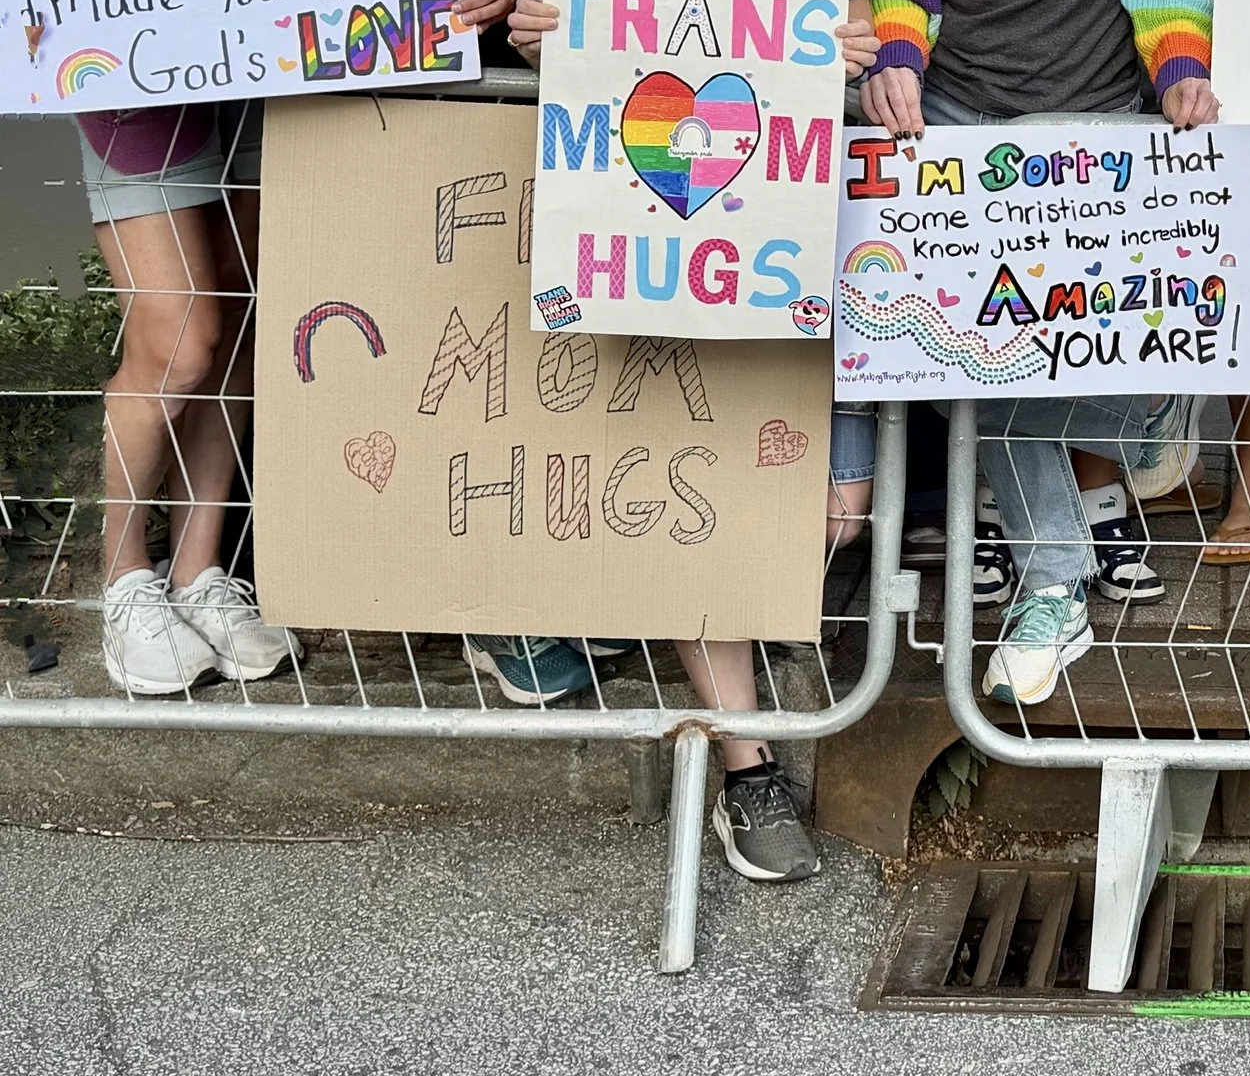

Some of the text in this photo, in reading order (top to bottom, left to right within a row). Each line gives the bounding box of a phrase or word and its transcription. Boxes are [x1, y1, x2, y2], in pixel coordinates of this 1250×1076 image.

[129, 28, 267, 94] God's
[979, 142, 1133, 192] Sorry
[1144, 132, 1225, 176] that
[879, 185, 1233, 234] Some Christians do not
[912, 220, 1220, 260] know just how incredibly
[576, 233, 804, 308] HUGS
[976, 262, 1228, 327] Amazing
[417, 302, 714, 422] MOM
[1032, 329, 1127, 381] YOU
[449, 445, 718, 545] HUGS
